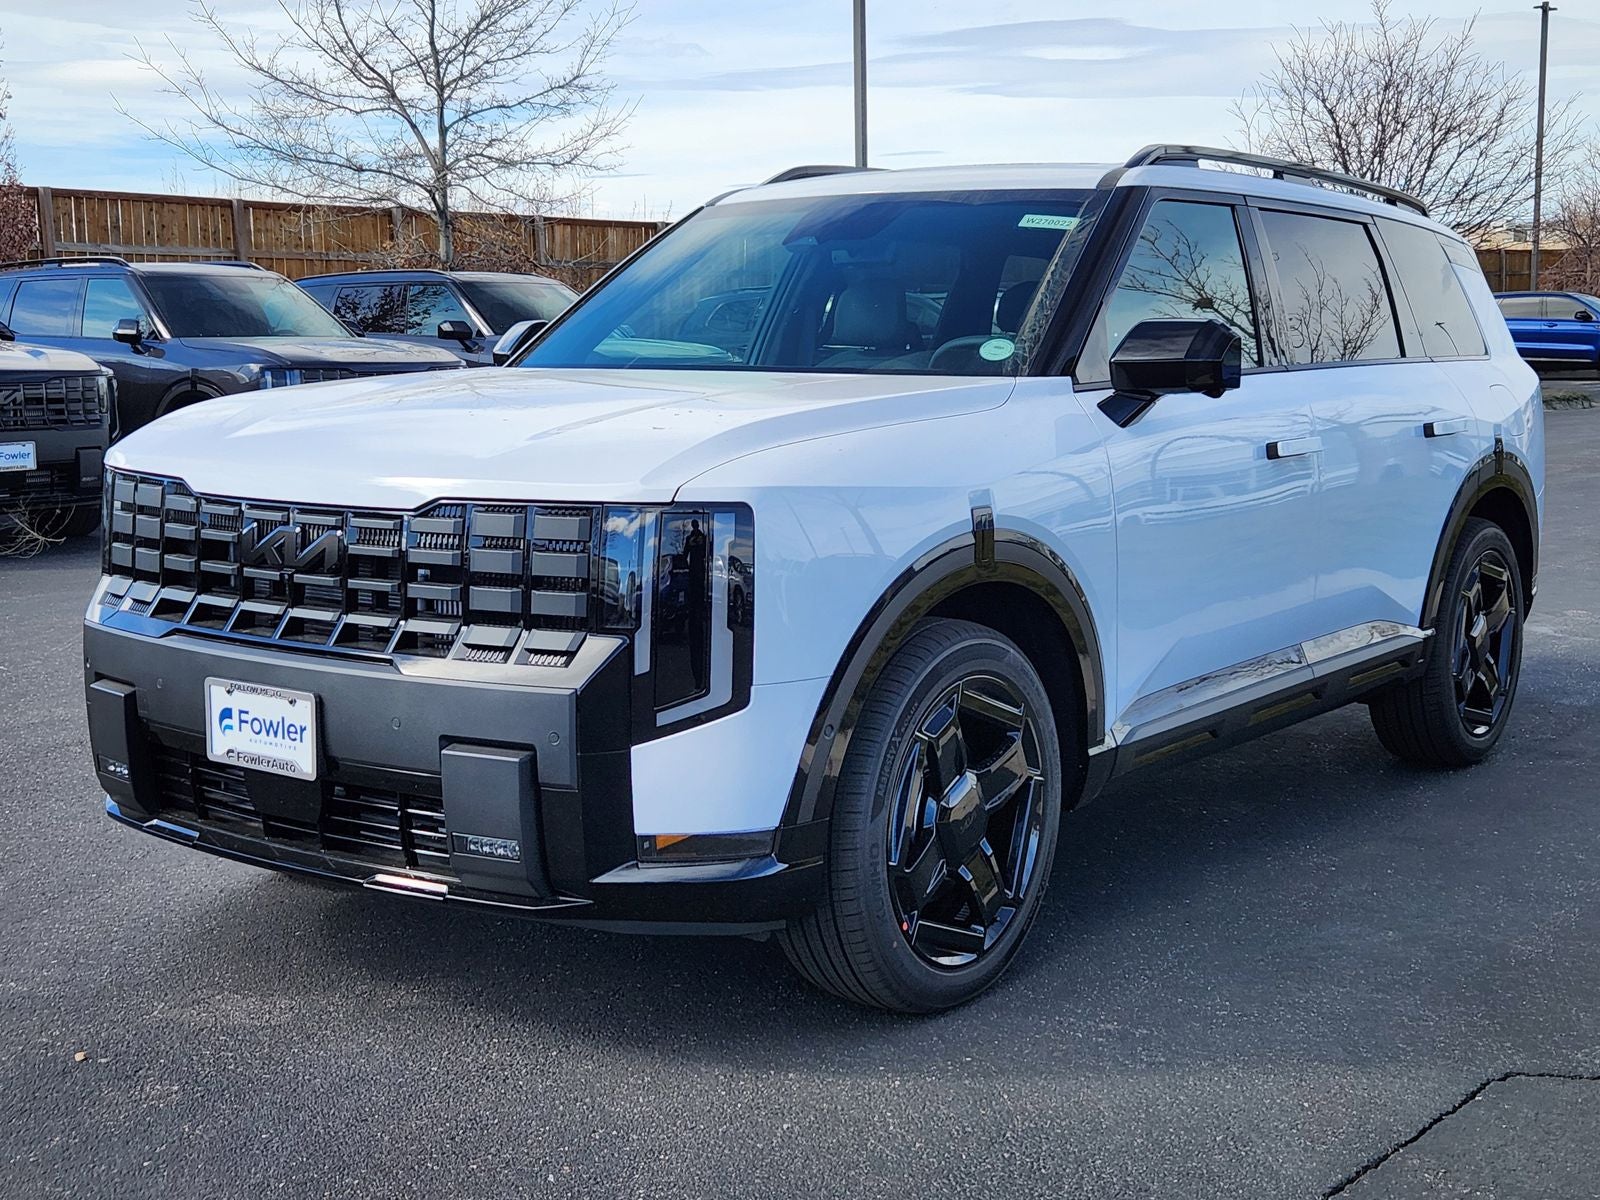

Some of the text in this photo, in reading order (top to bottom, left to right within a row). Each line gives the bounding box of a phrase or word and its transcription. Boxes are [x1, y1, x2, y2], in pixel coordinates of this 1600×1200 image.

[241, 521, 343, 574] KIA
[238, 708, 307, 743] Fowler
[236, 751, 296, 773] FowlerAuto
